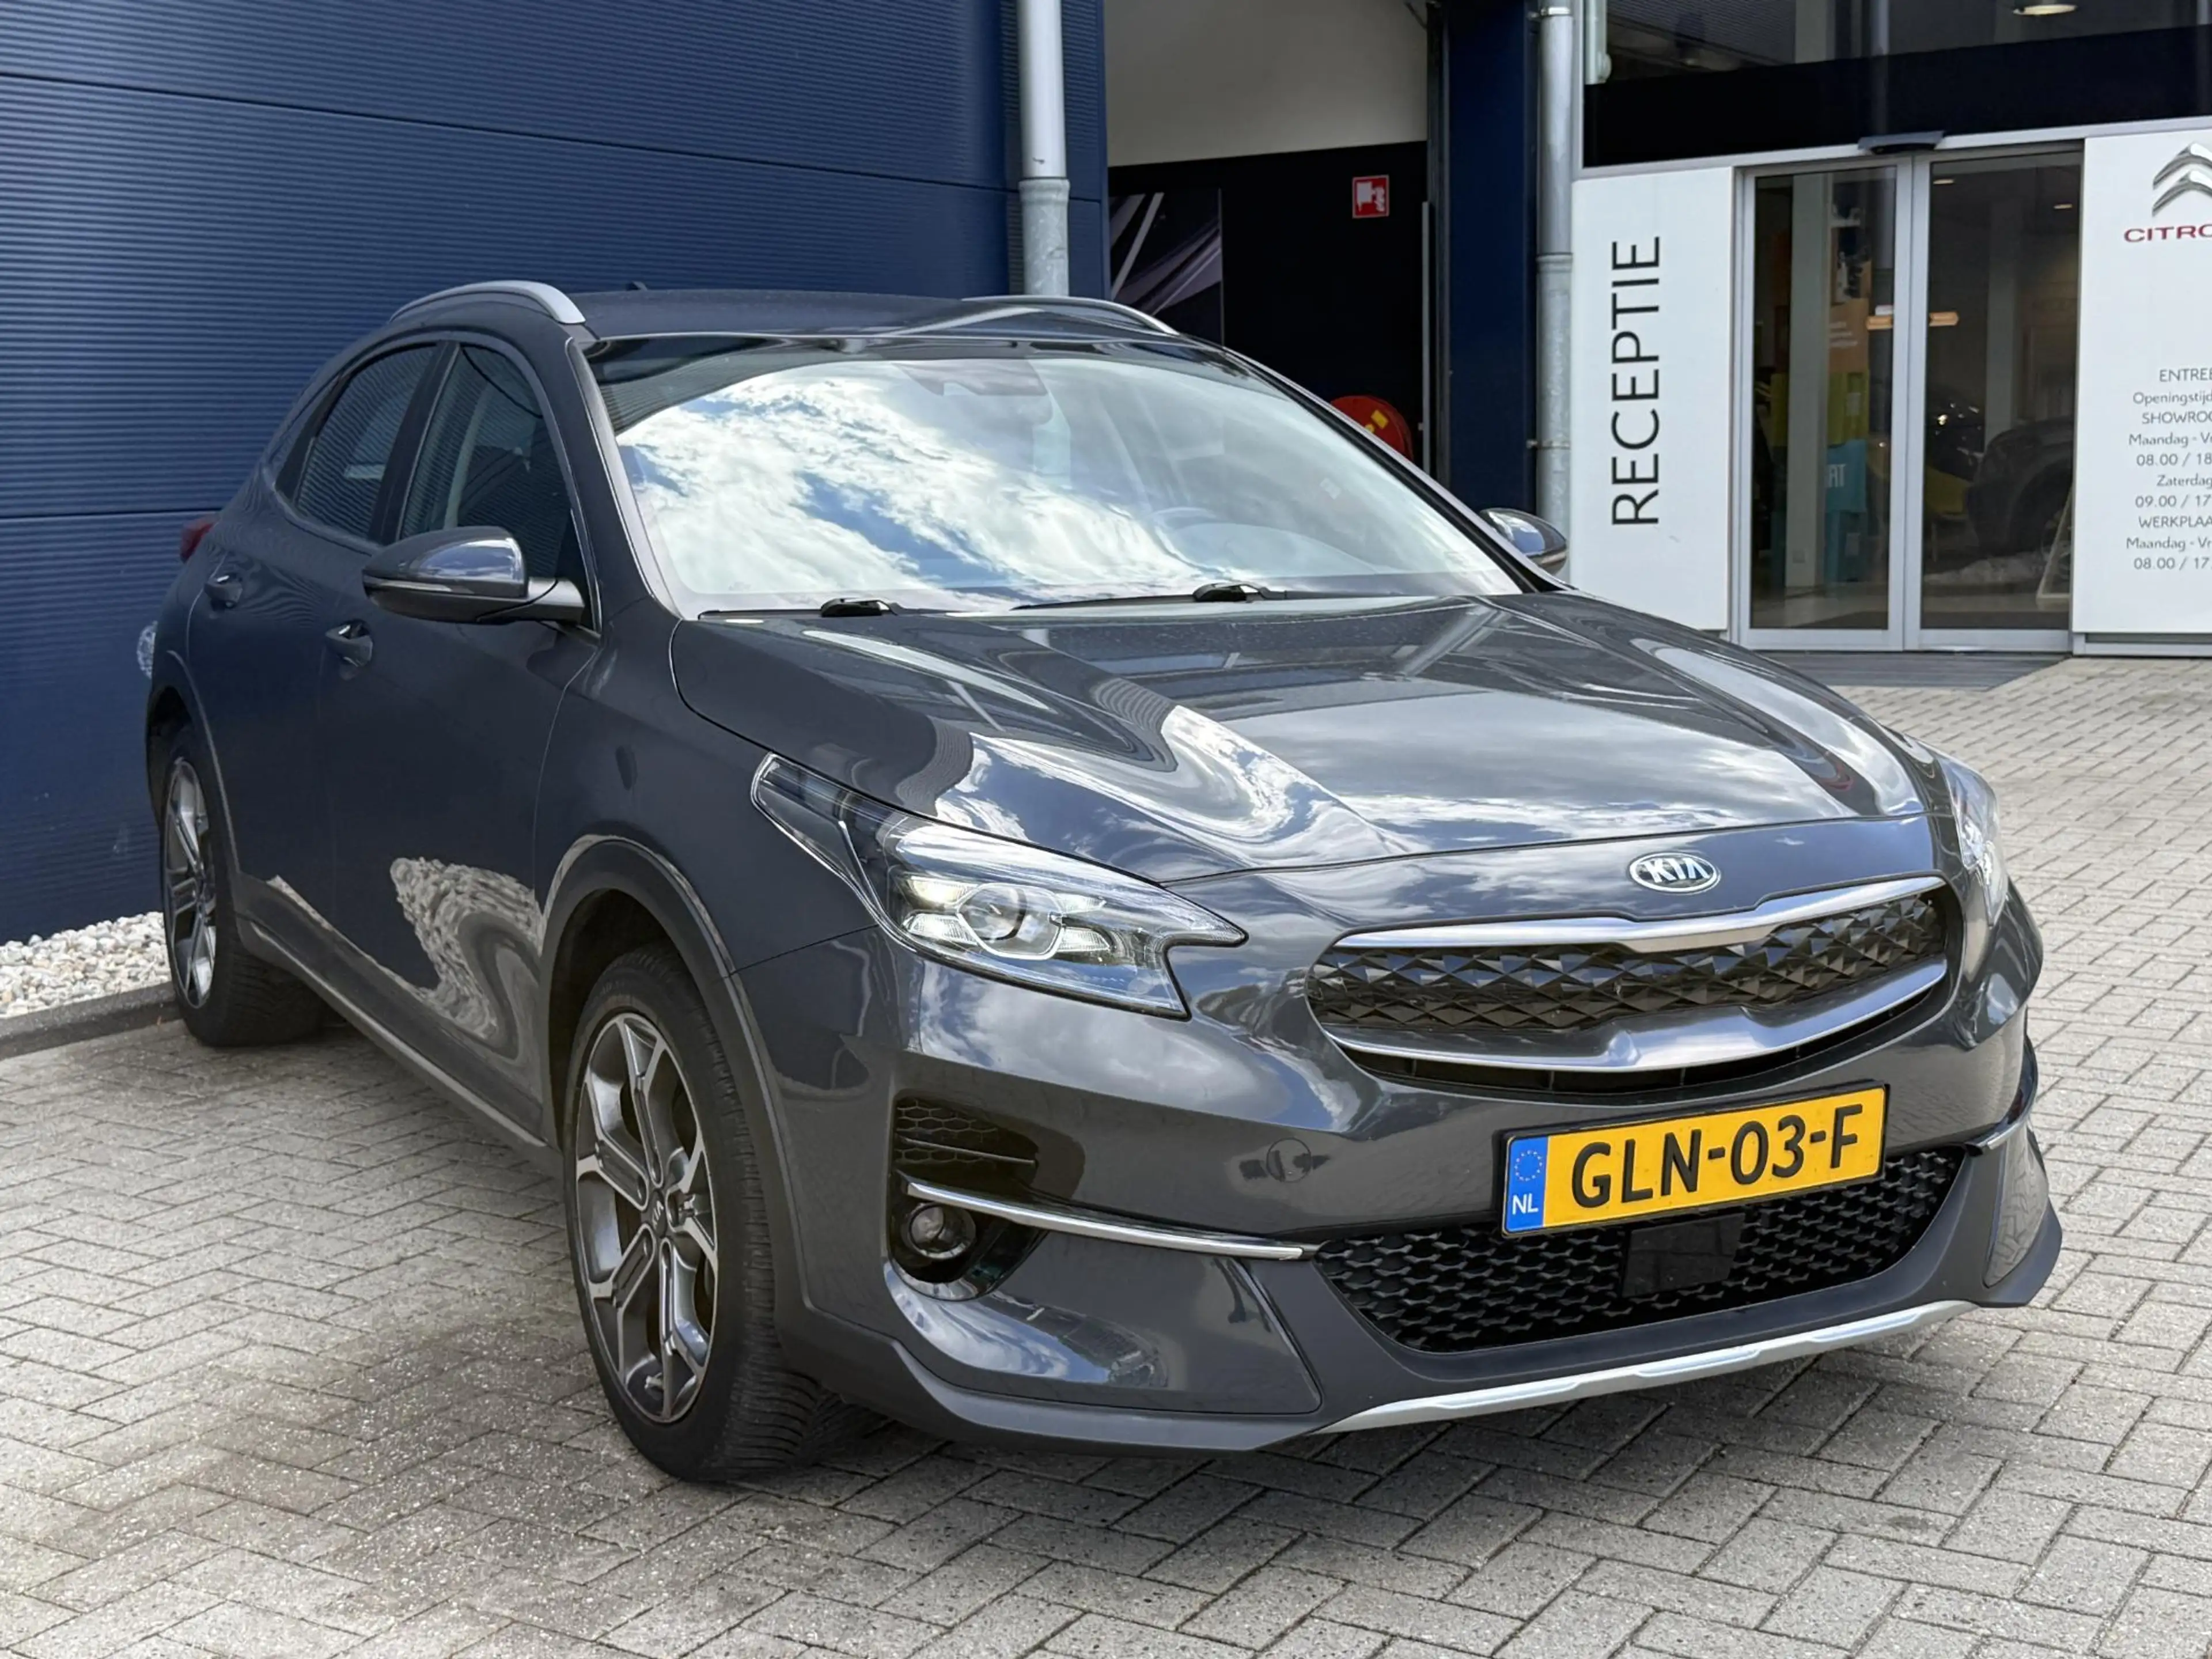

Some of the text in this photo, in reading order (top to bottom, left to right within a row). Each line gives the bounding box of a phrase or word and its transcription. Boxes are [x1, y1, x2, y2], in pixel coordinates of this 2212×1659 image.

[1611, 237, 1660, 525] RECEPTIE
[2129, 431, 2188, 448] Maandag
[2137, 454, 2178, 466] 08.00
[2156, 472, 2212, 490] Zaterdag
[2135, 495, 2177, 508] 09.00
[2126, 536, 2186, 552] Maandag
[2134, 557, 2175, 570] 08.00
[1641, 857, 1711, 883] KIA
[1571, 1103, 1863, 1208] GLN-03-F
[1512, 1193, 1539, 1215] NL
